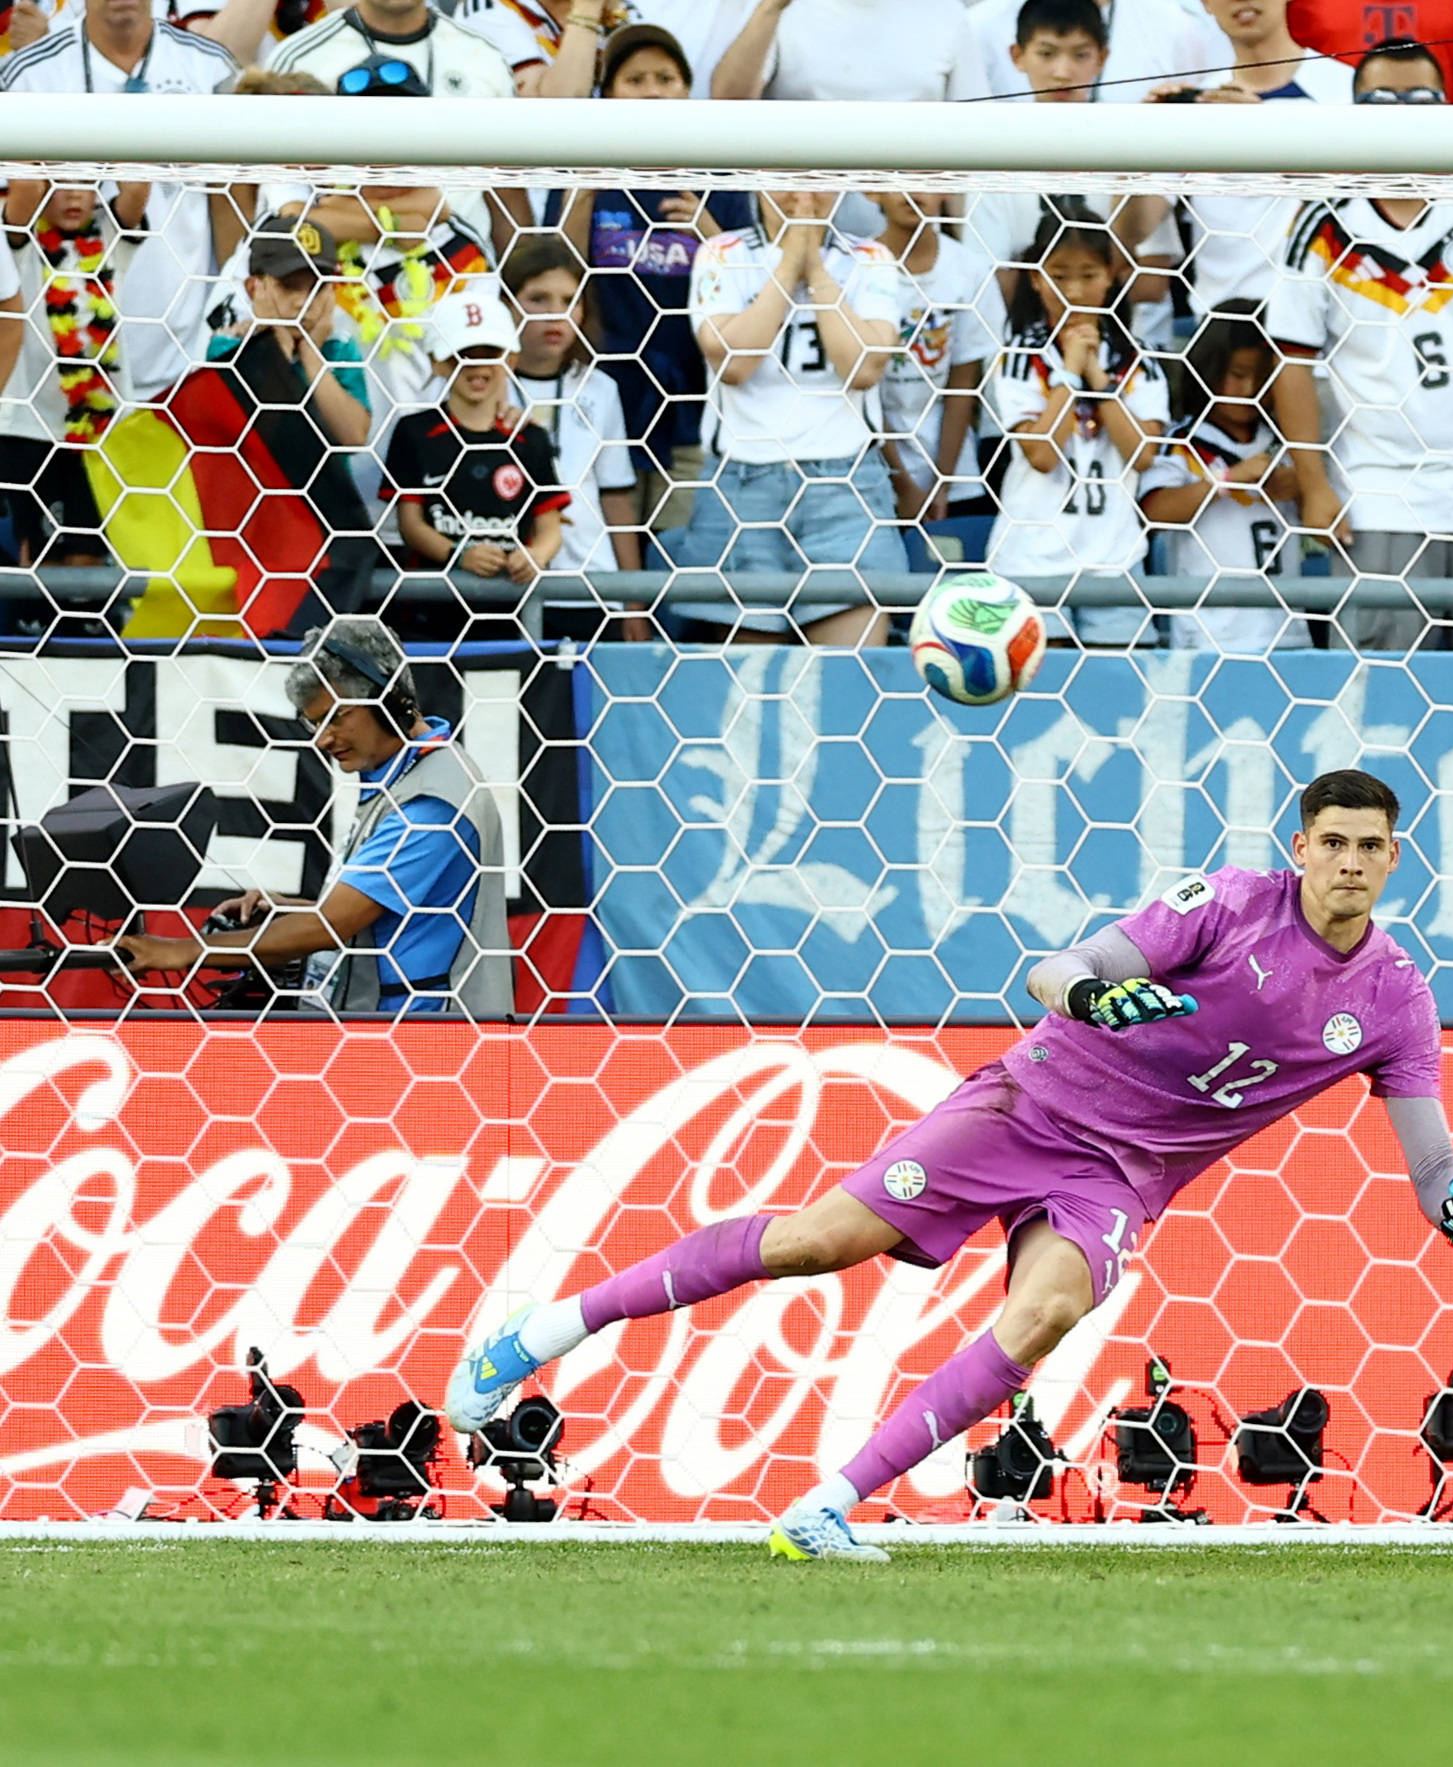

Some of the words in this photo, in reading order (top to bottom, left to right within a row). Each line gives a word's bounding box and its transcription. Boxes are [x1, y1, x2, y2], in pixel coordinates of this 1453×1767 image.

[627, 238, 690, 266] USA
[463, 304, 483, 328] B
[780, 322, 826, 372] 13
[1413, 331, 1450, 390] 6
[1252, 520, 1283, 575] 6
[1187, 1041, 1279, 1109] 12
